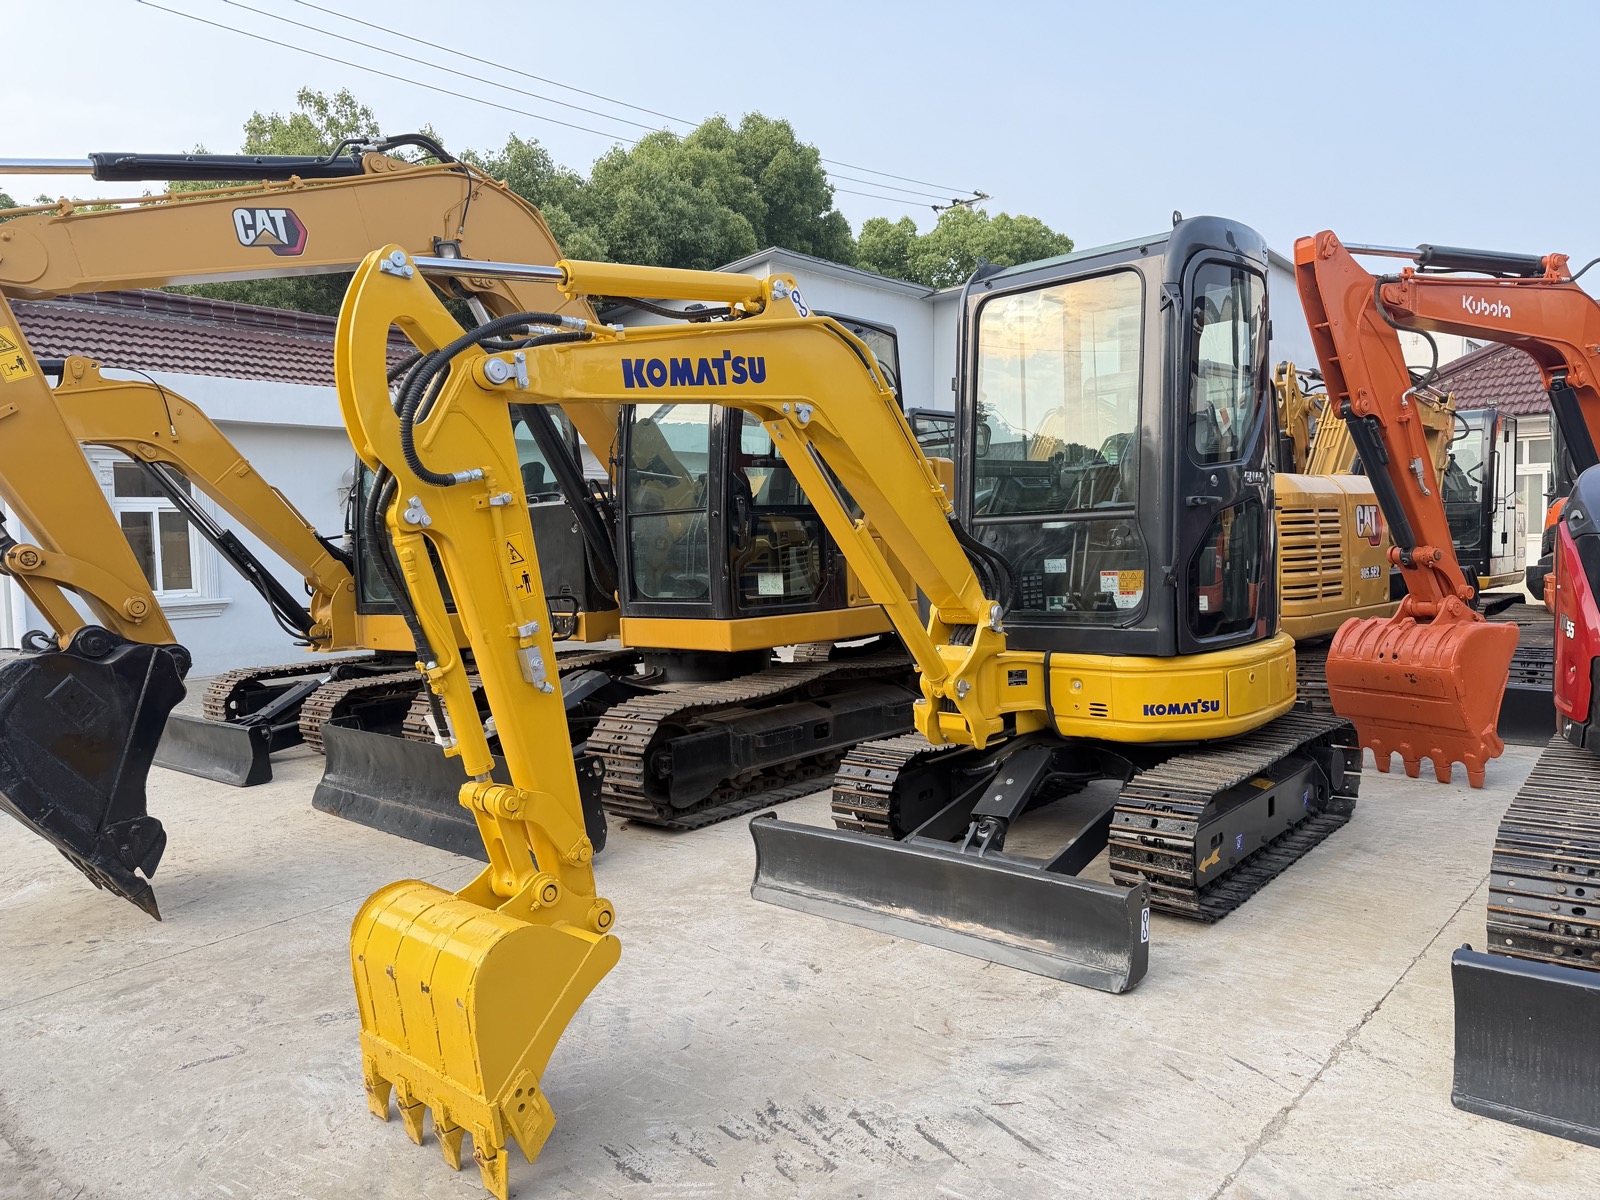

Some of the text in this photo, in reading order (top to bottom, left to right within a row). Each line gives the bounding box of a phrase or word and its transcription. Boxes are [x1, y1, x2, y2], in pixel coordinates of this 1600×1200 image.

[233, 208, 289, 246] CAT
[1462, 294, 1511, 318] Kubota
[621, 350, 767, 388] KOMATSU
[1356, 505, 1377, 537] CAT
[1143, 698, 1220, 716] KOMATSU
